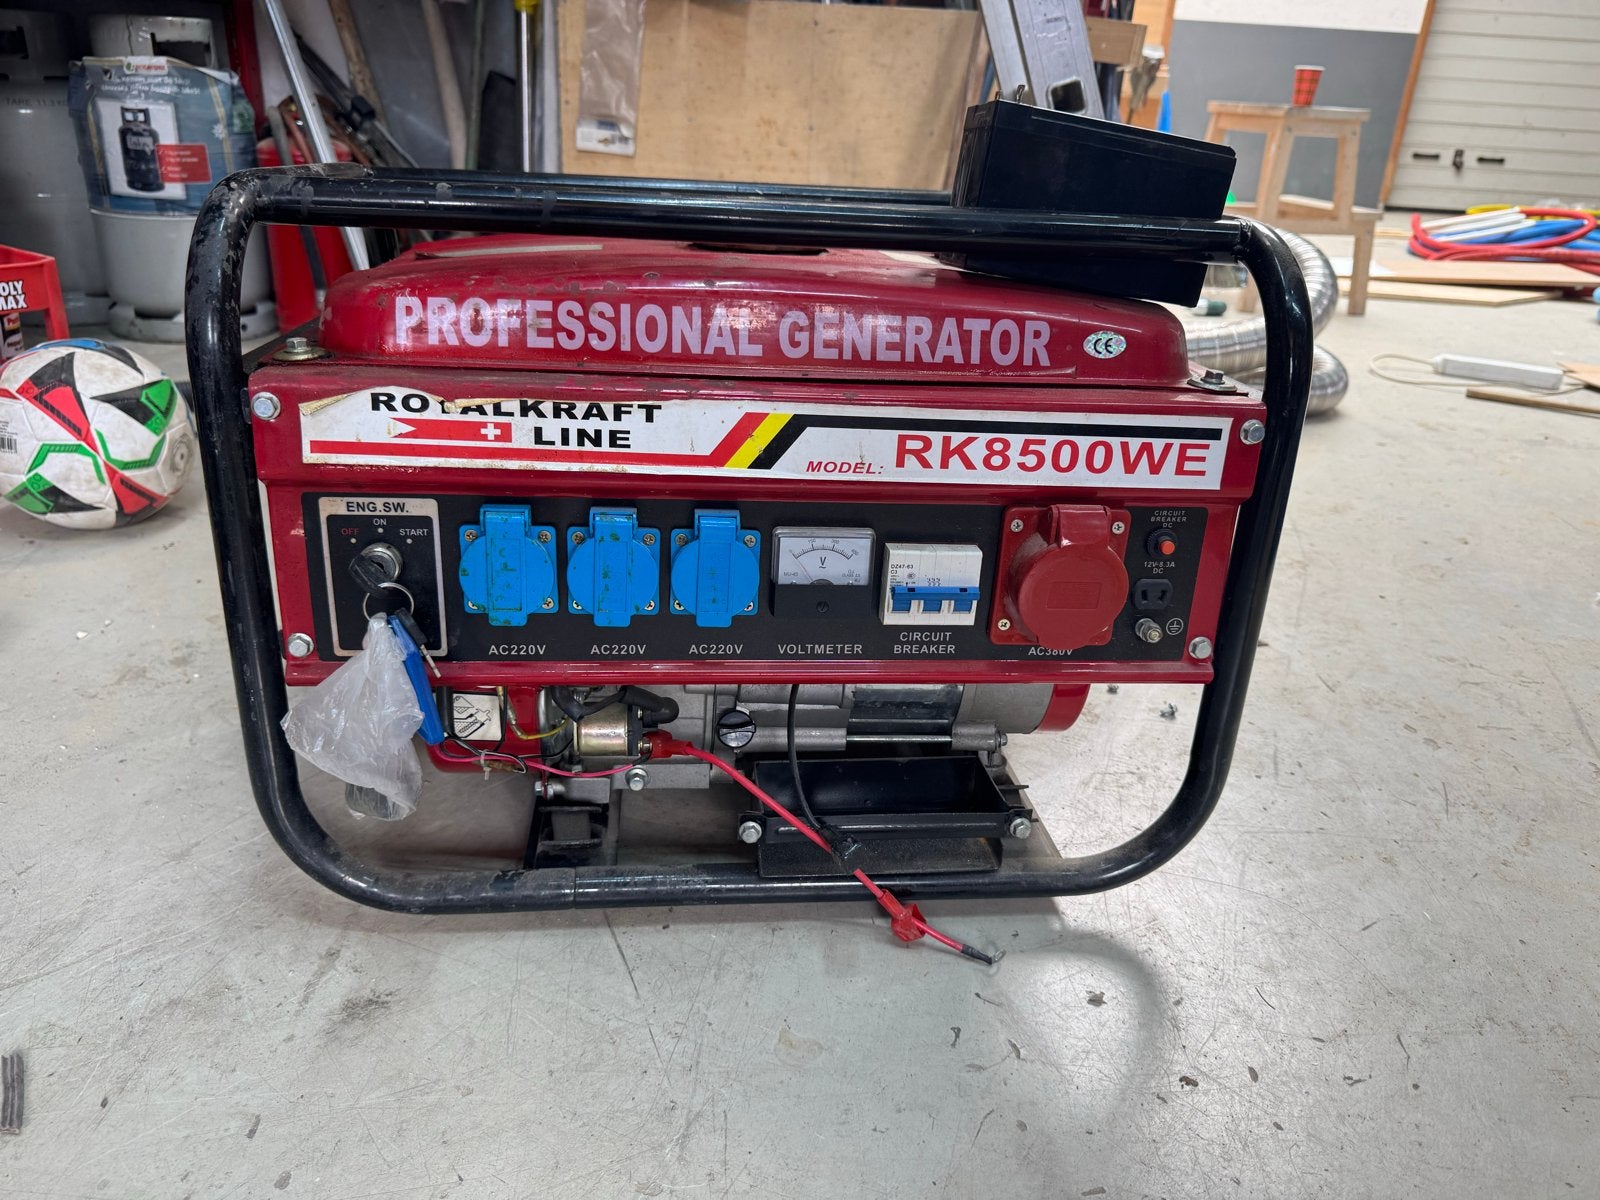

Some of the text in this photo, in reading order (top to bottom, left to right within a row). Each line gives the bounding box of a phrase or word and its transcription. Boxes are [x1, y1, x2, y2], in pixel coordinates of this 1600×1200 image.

[395, 296, 1051, 367] PROFESSIONAL GENERATOR
[1093, 337, 1114, 355] CE
[533, 426, 631, 449] LINE
[805, 433, 1211, 477] MODEL: RK8500WE
[346, 501, 409, 513] ENG.SW.
[373, 518, 387, 526] ON
[399, 528, 429, 536] START
[820, 556, 827, 566] V
[900, 631, 952, 642] CIRCUIT
[488, 644, 547, 656] AC220V
[590, 644, 647, 656] AC220V
[688, 644, 744, 656] AC220V
[777, 643, 863, 655] VOLTMETER
[893, 644, 956, 654] BREAKER
